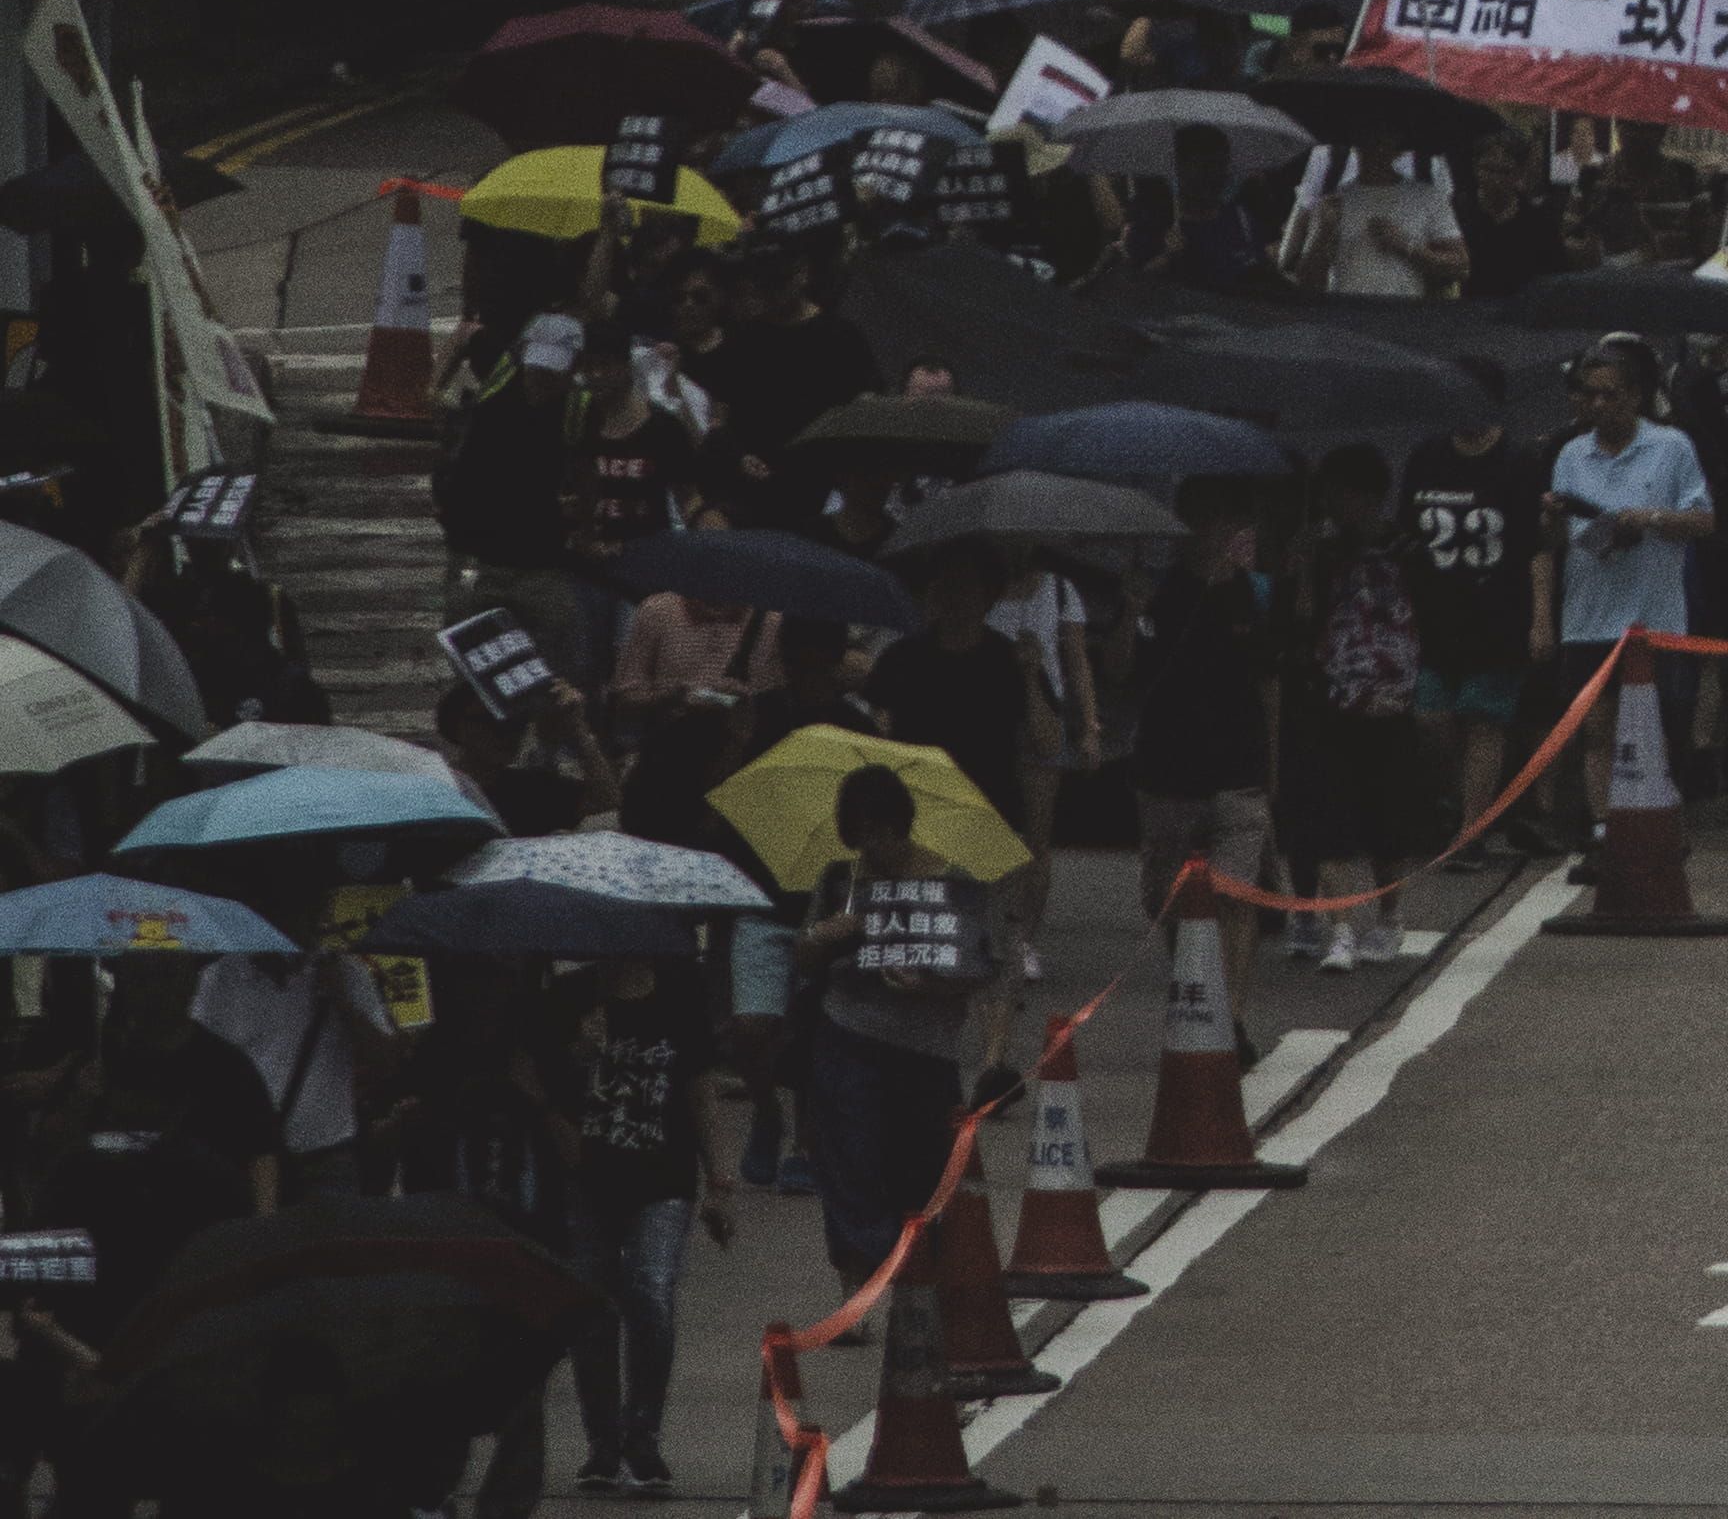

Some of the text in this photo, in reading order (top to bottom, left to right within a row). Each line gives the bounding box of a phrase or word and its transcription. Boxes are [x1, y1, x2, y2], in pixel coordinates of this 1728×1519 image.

[1418, 506, 1504, 568] 23
[870, 880, 946, 903] 反威權
[857, 943, 959, 969] 拒絕沉淪
